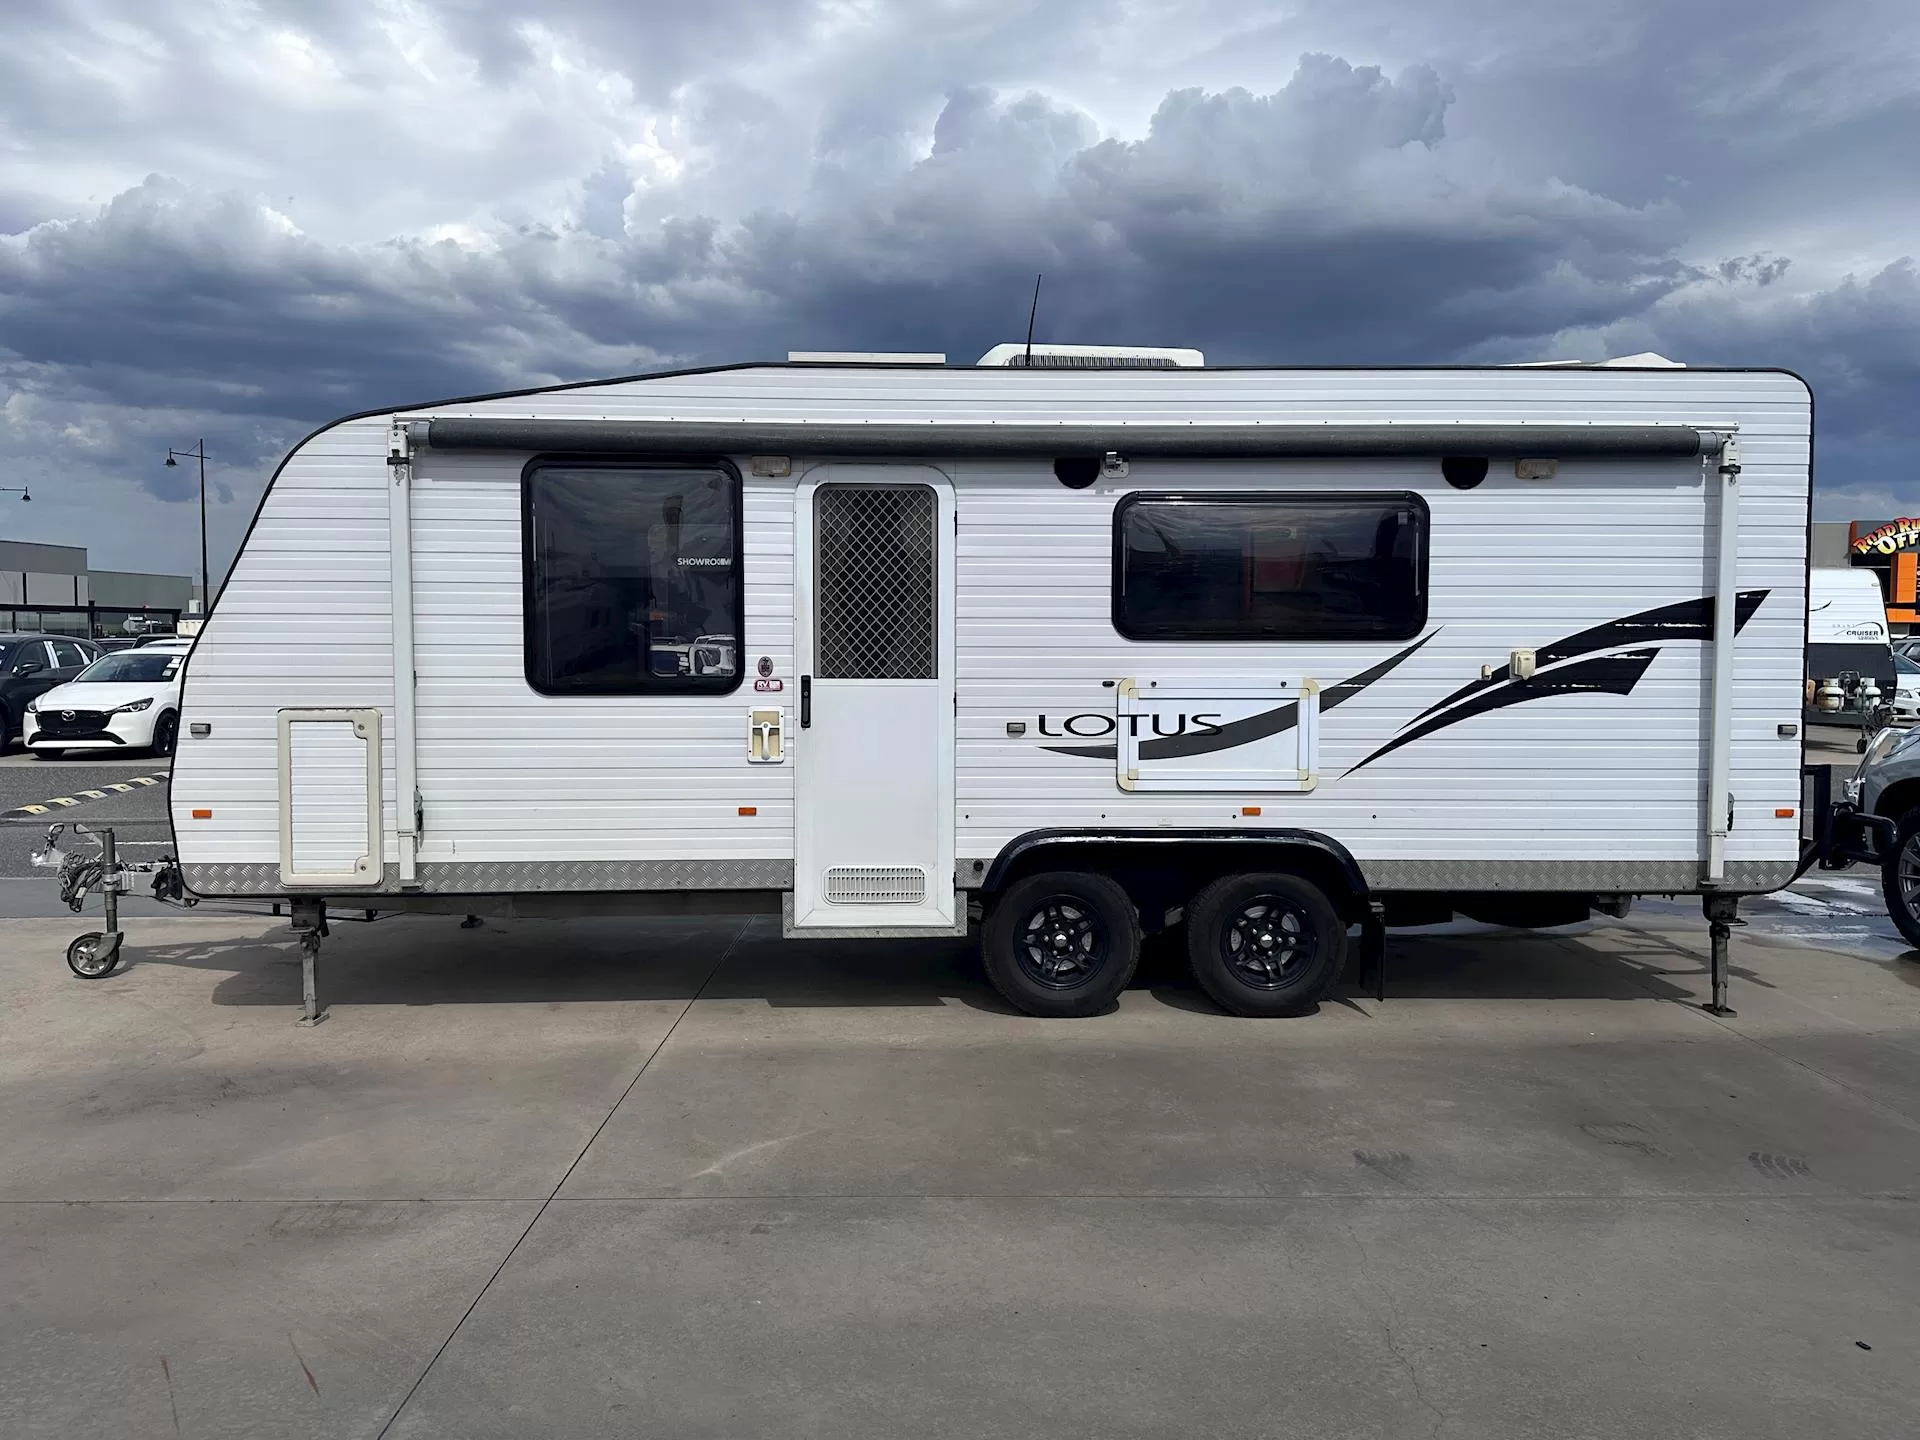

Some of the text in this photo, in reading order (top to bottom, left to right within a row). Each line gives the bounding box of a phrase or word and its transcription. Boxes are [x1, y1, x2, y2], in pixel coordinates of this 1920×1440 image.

[1853, 524, 1897, 554] ROAD
[1873, 529, 1920, 555] OFF
[1038, 713, 1223, 737] LOTUS
